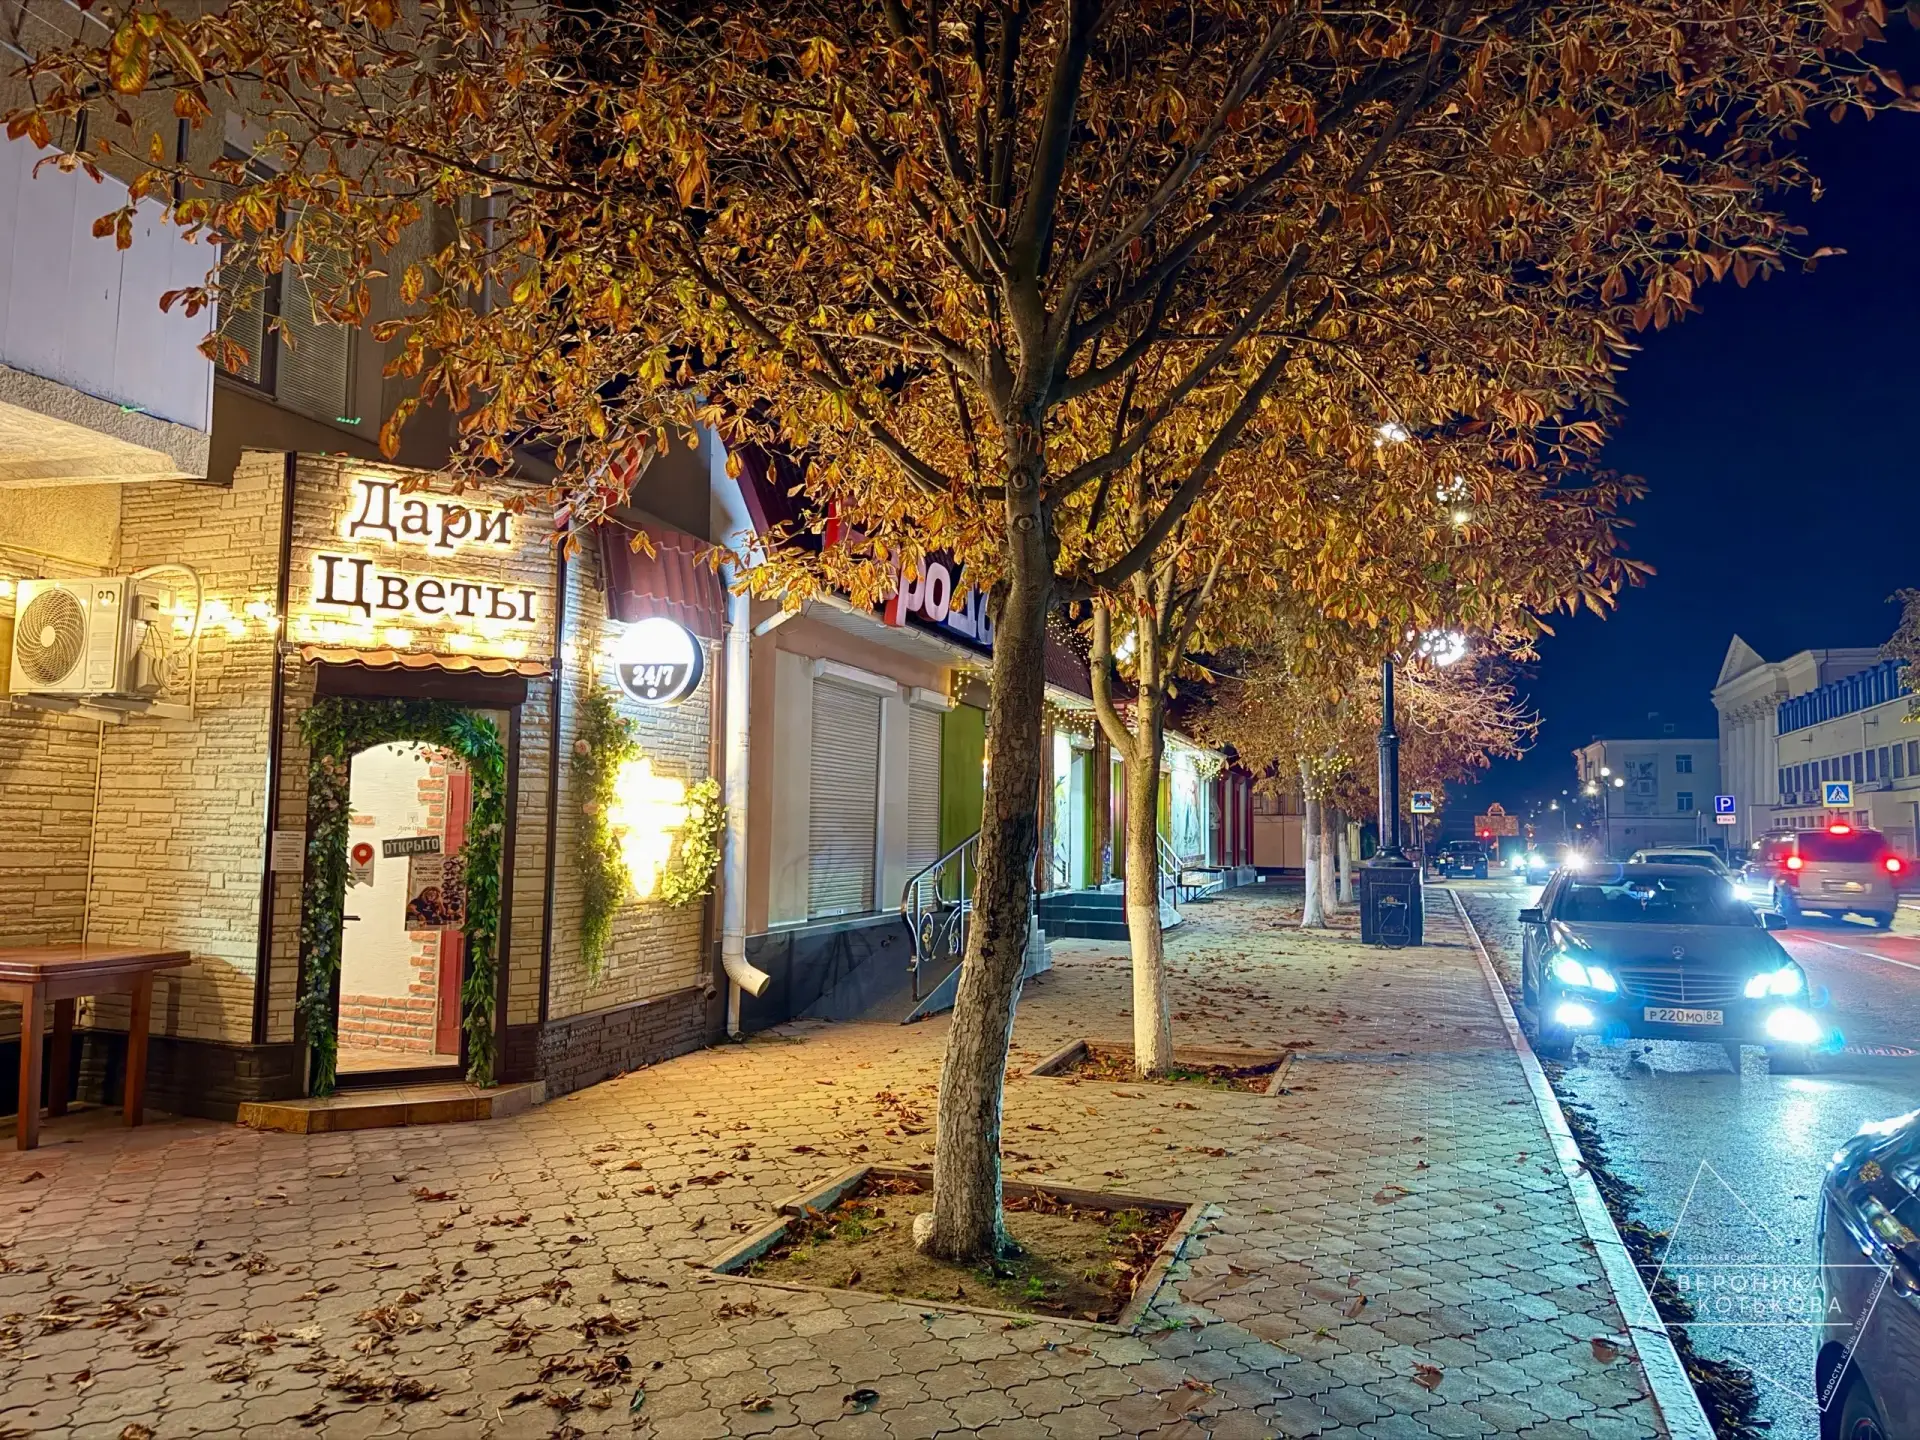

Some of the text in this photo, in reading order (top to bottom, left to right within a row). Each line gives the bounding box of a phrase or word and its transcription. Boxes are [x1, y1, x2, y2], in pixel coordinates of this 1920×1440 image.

[350, 479, 512, 548] Дари
[315, 555, 537, 623] Цветы
[632, 665, 675, 687] 24/7
[384, 838, 439, 855] ОТКРЫТО
